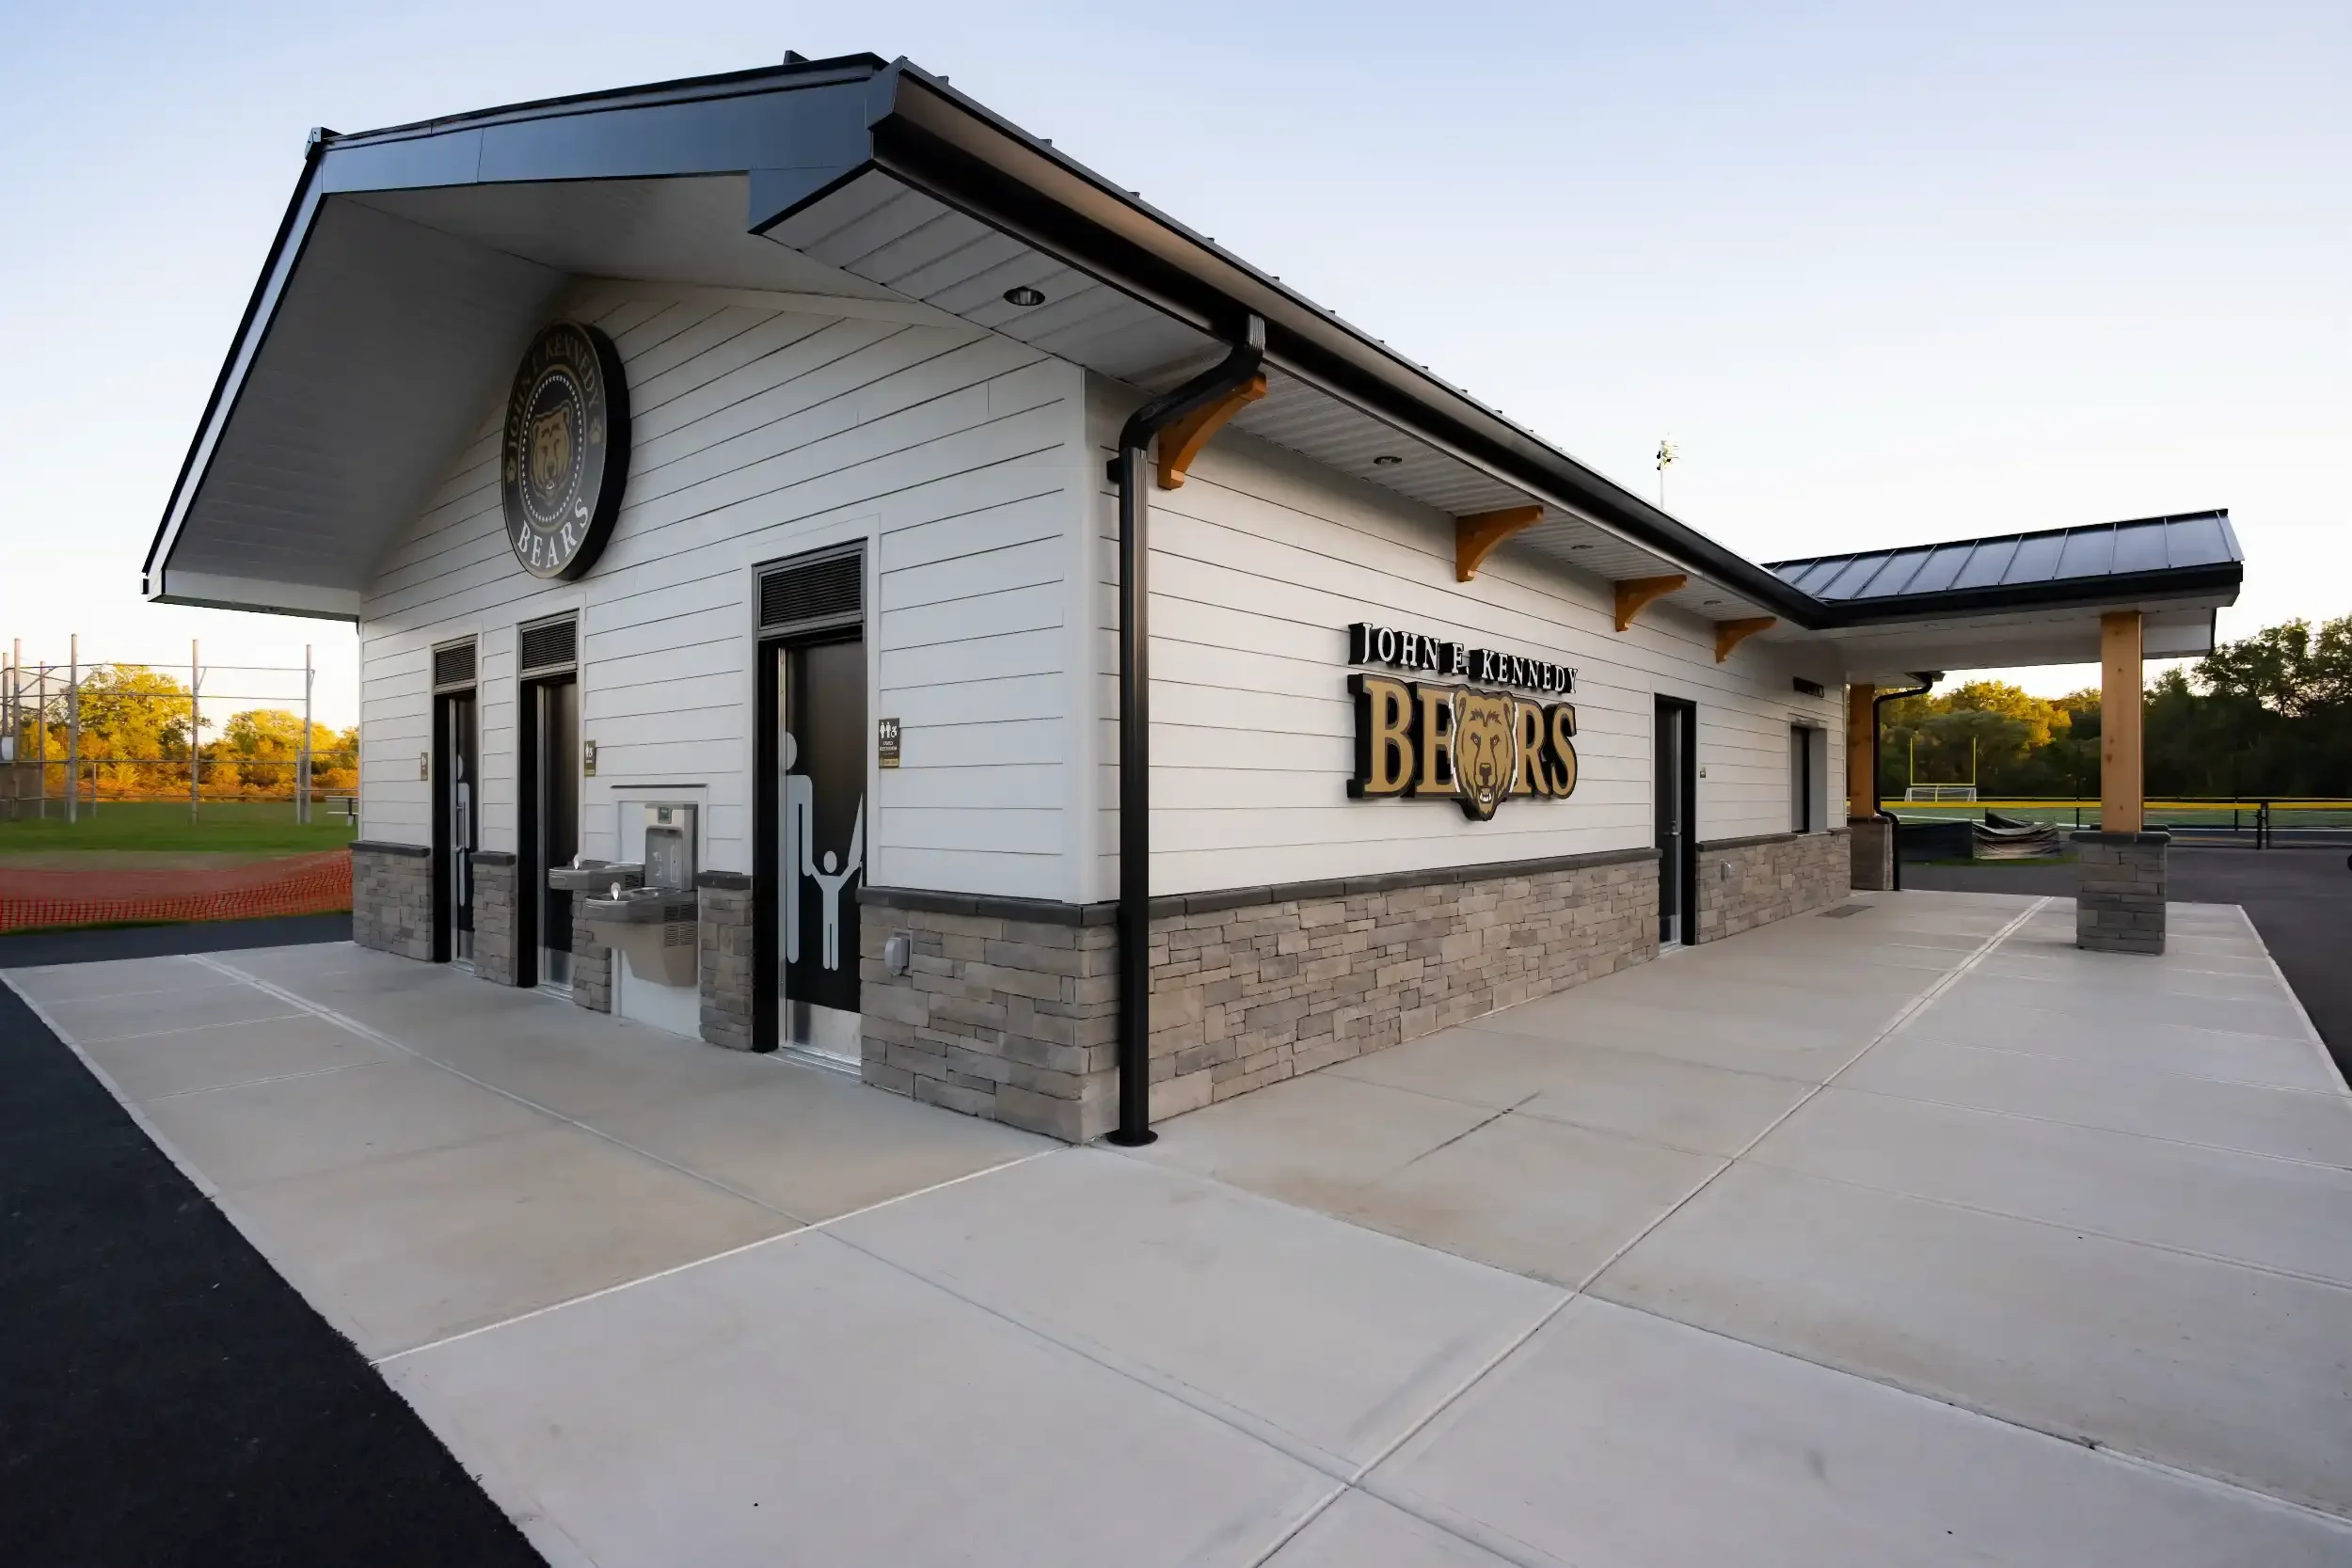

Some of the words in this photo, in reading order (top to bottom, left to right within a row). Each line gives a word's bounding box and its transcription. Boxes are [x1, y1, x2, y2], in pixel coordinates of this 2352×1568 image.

[546, 333, 599, 410] KENNEDY
[517, 496, 589, 569] BEARS
[1362, 623, 1439, 670] JOHN
[1482, 648, 1579, 693] KENNEDY
[1363, 674, 1578, 799] BERS
